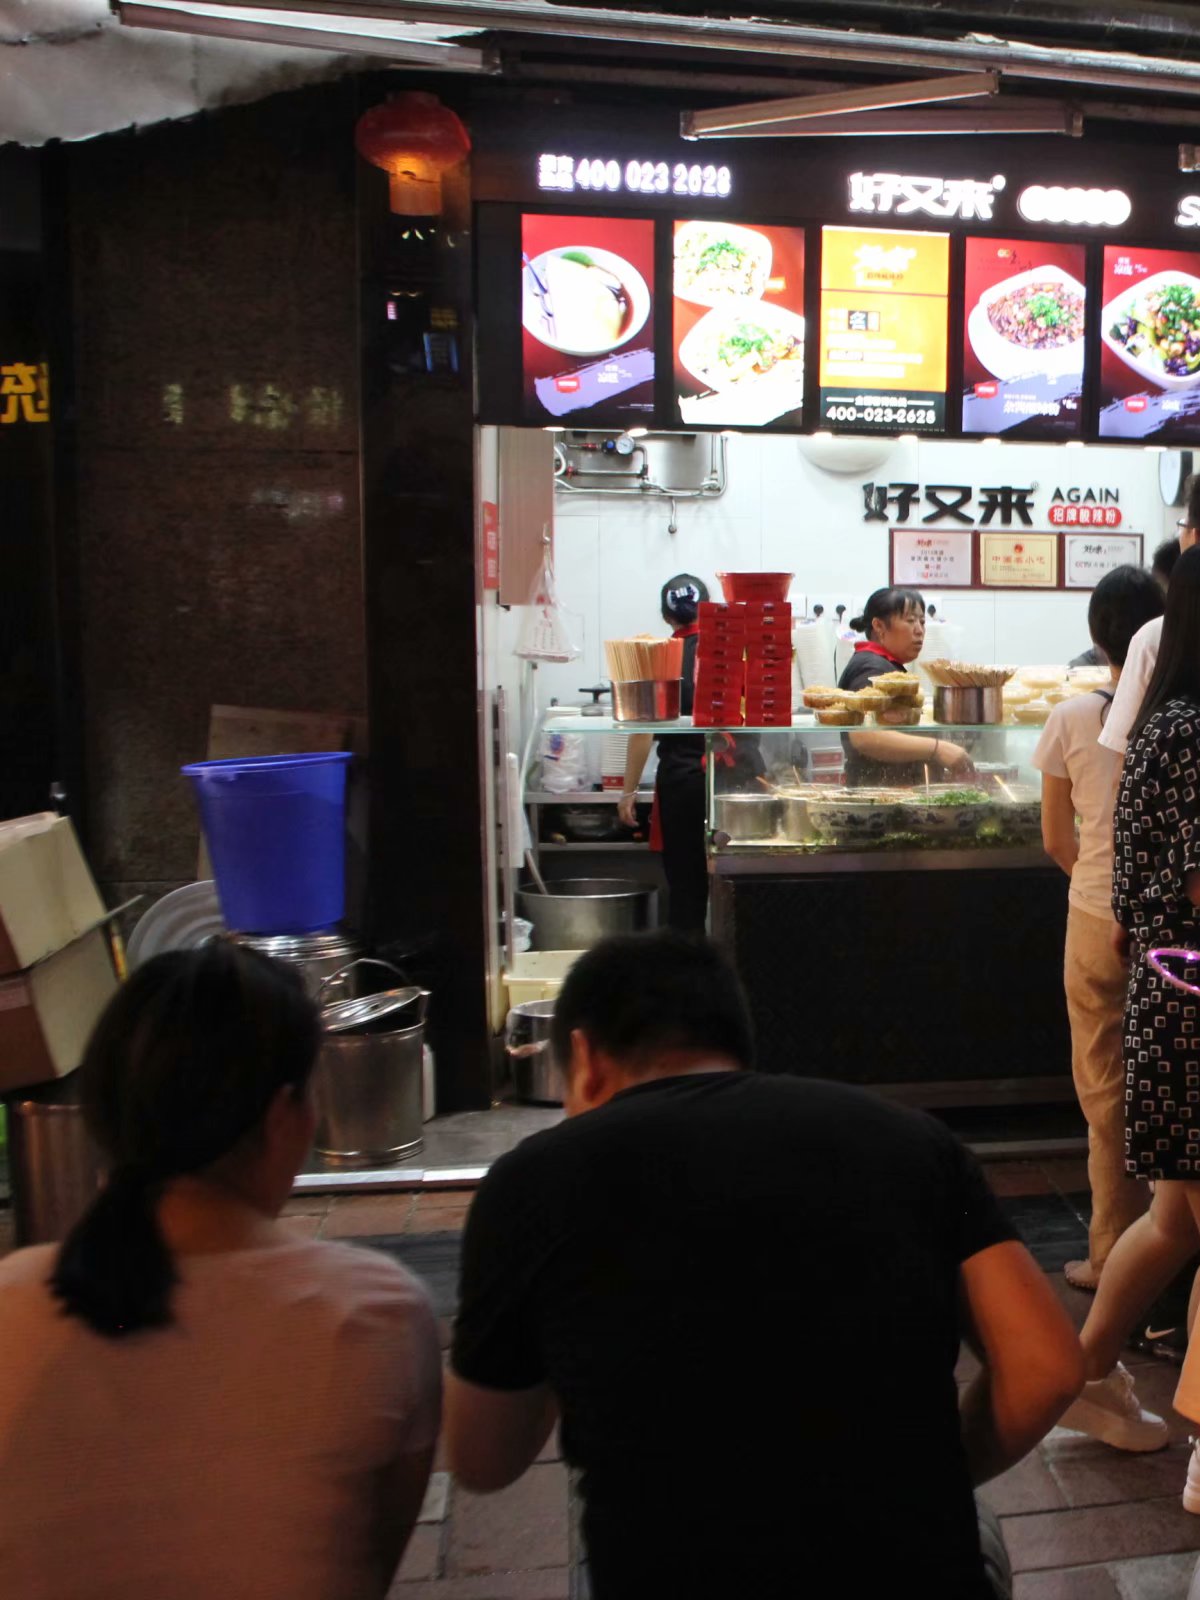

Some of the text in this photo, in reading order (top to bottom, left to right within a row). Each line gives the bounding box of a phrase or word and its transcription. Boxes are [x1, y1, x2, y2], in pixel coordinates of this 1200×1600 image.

[575, 158, 621, 191] 400
[625, 160, 670, 193] 023
[673, 163, 732, 197] 2628
[848, 171, 995, 220] 好又来
[825, 405, 937, 425] 400-023-2628
[862, 483, 1034, 525] 好又来
[1051, 487, 1120, 503] AGAIN
[1053, 508, 1116, 525] 招牌酸辣粉
